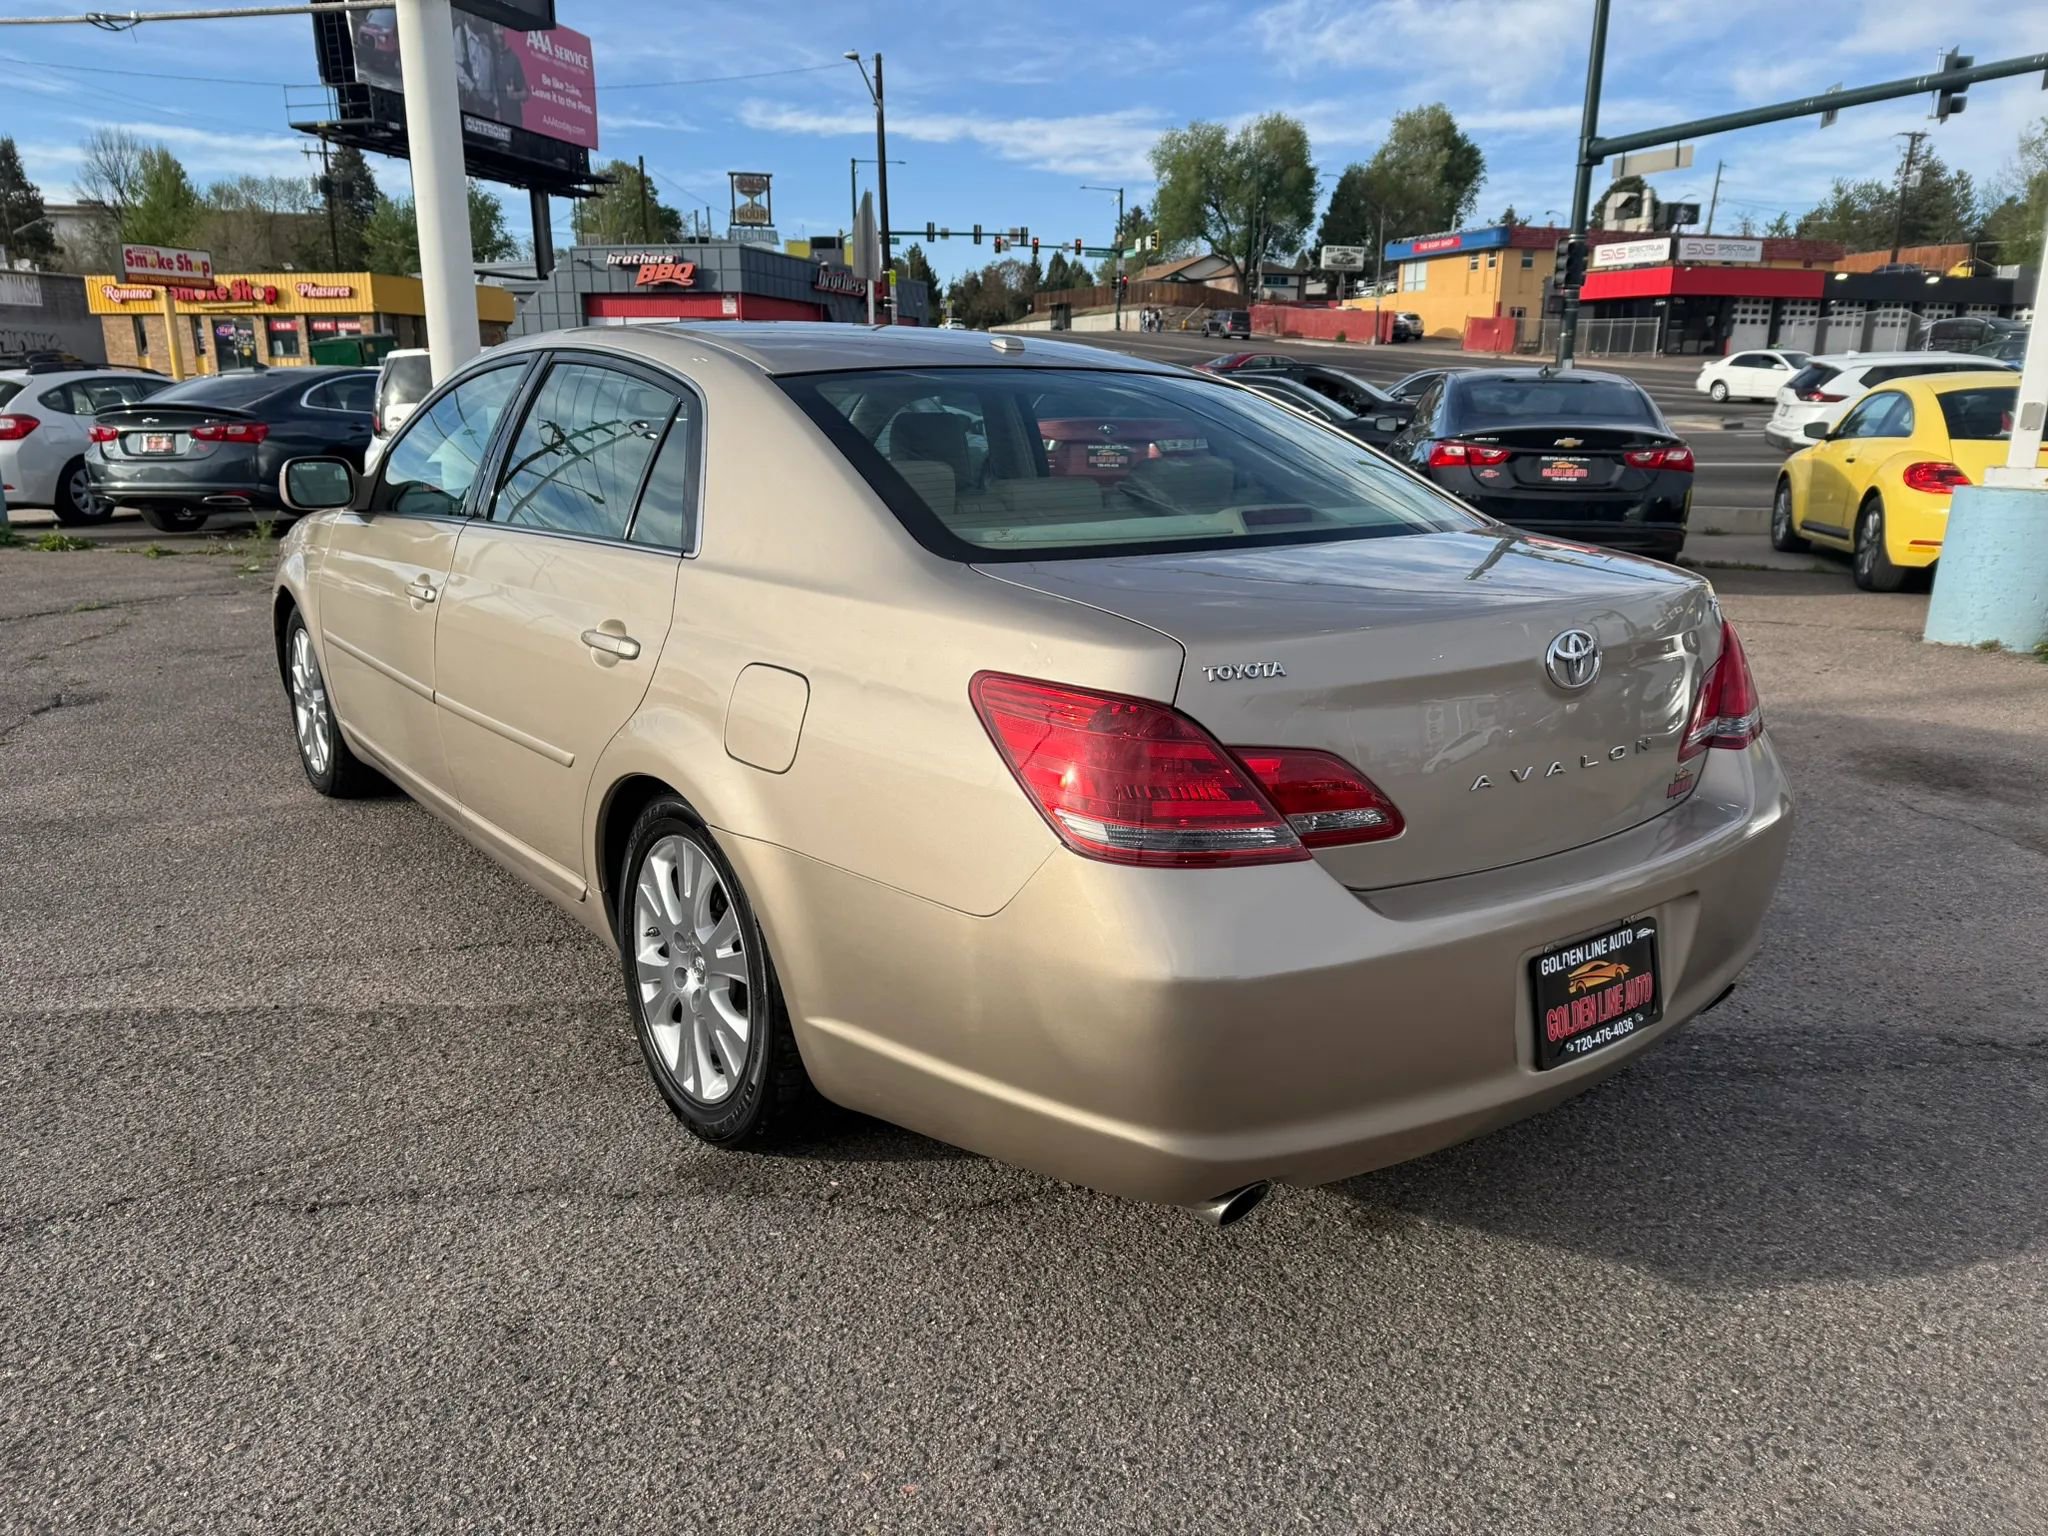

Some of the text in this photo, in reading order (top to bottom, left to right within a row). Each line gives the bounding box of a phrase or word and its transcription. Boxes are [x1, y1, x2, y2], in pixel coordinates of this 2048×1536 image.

[526, 30, 552, 56] AAA
[554, 44, 589, 70] SERVICE
[531, 84, 551, 101] Leave
[465, 117, 510, 141] OUTFRONT
[739, 208, 766, 220] HOUR
[124, 248, 210, 277] Smoke Shop
[606, 253, 674, 264] brothers
[635, 263, 696, 286] BBQ
[819, 269, 866, 293] brothers
[102, 284, 153, 304] Romance
[231, 279, 277, 305] Shop
[296, 283, 351, 298] Pleasures
[1202, 661, 1287, 682] TOYOTA
[1470, 736, 1652, 792] AVALON
[1541, 929, 1633, 976] GOLDEN LINE AUTO
[1546, 971, 1653, 1042] GOLDEN LINE AUTO
[1574, 1017, 1634, 1053] 720-476-4036
